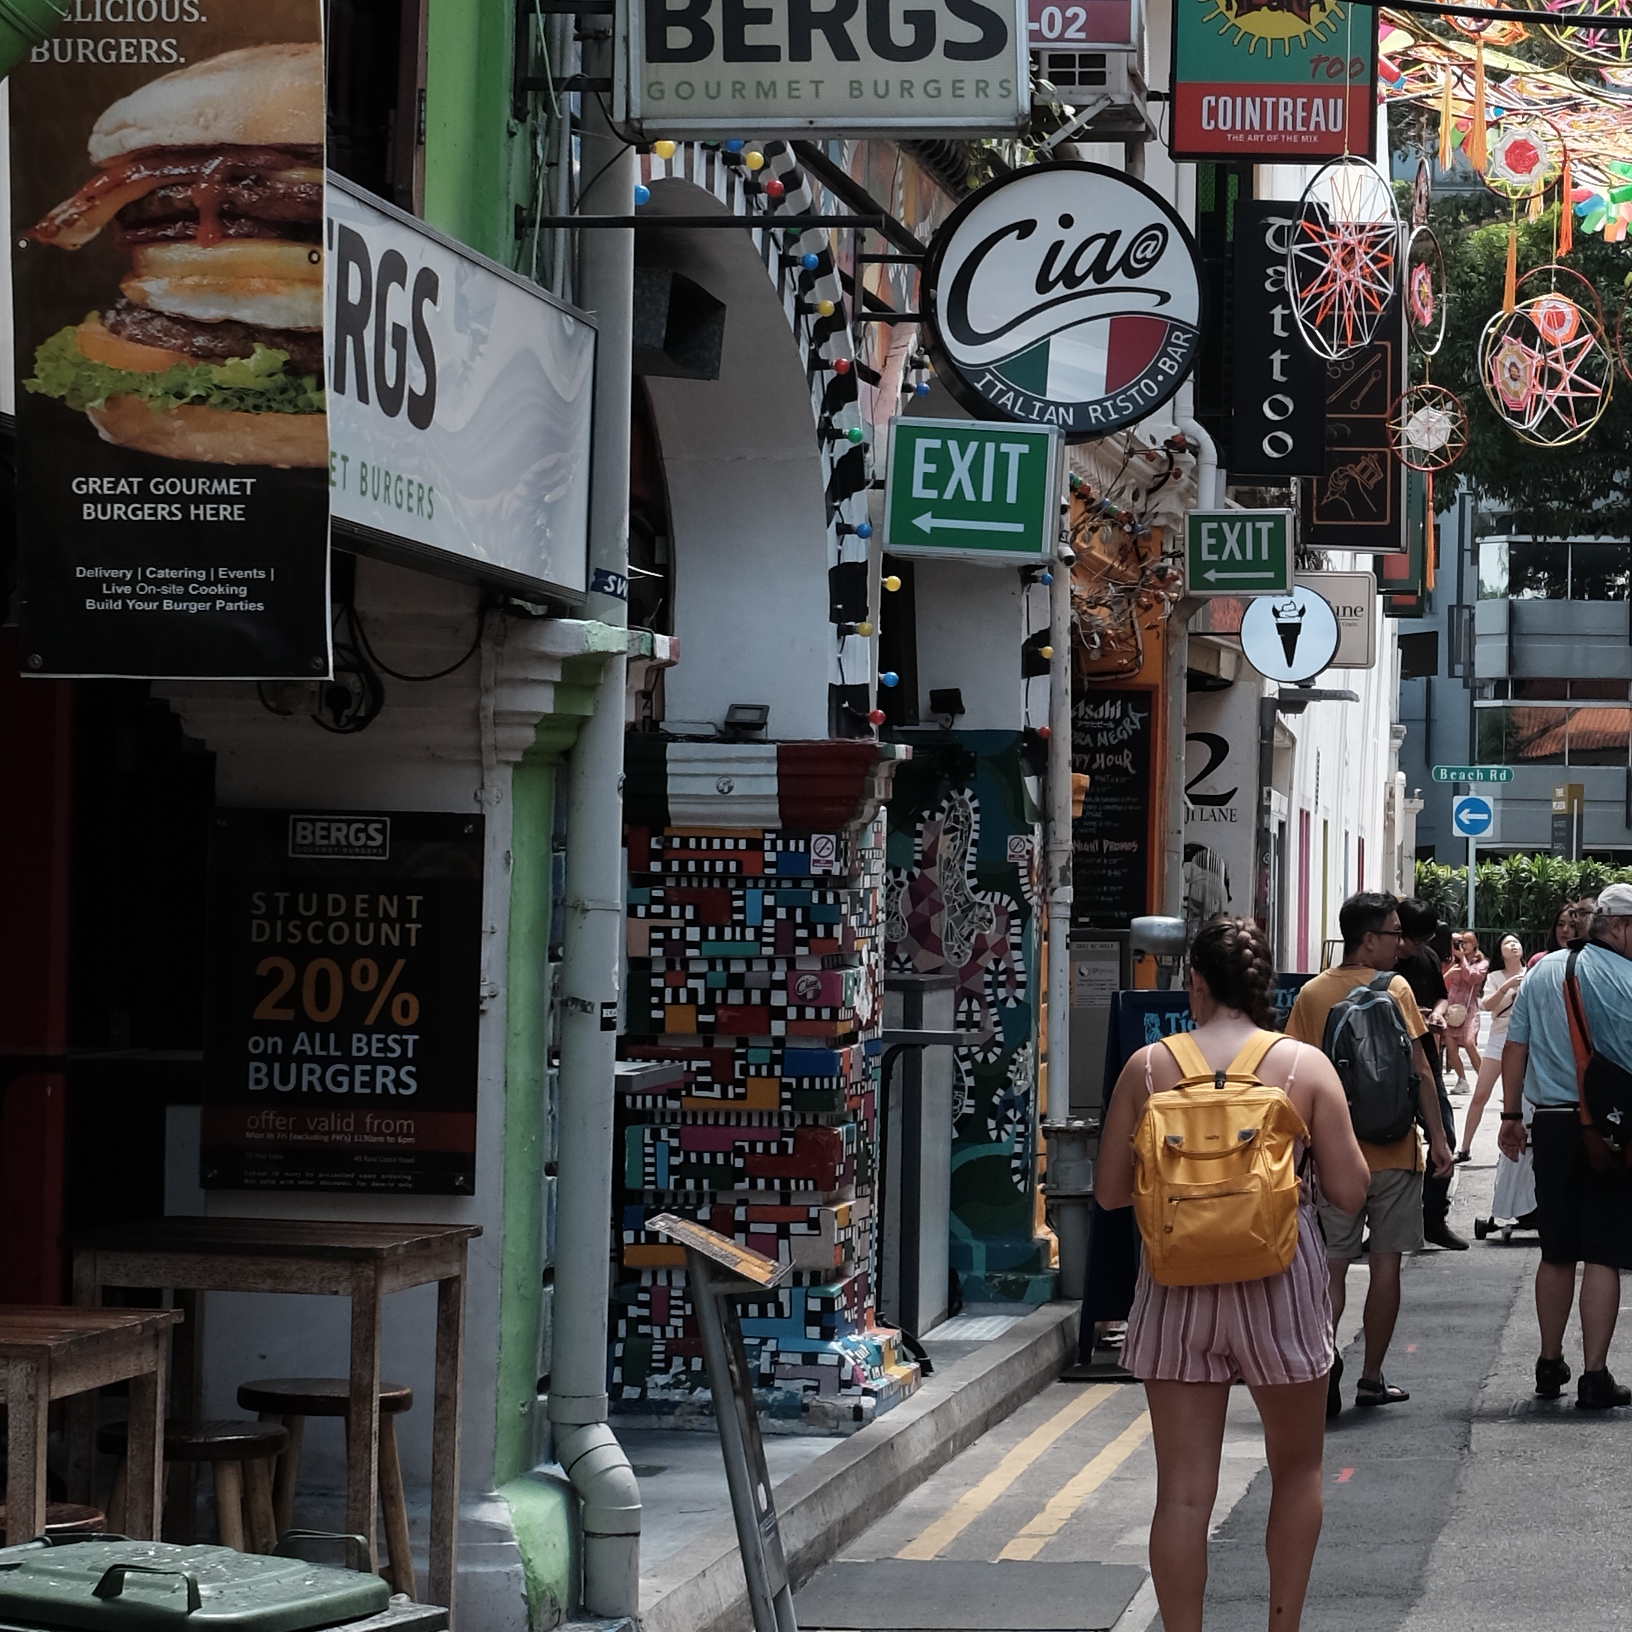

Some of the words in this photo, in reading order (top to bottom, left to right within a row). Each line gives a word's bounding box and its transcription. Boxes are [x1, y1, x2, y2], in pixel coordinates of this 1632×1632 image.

[646, 79, 825, 102] GOURMET
[849, 76, 1014, 100] BURGERS
[1201, 95, 1345, 133] COINTREAU
[1226, 134, 1246, 144] THE
[1247, 134, 1264, 144] ART
[1266, 134, 1279, 144] OF
[1281, 134, 1299, 144] THE
[327, 216, 440, 431] RGS
[973, 370, 1075, 427] ITALIAN
[912, 436, 1031, 504] EXIT
[71, 477, 144, 495] GREAT
[149, 477, 257, 495] GOURMET
[359, 460, 435, 521] BURGERS
[82, 503, 183, 521] BURGERS
[189, 504, 246, 521] HERE
[1200, 520, 1276, 562] EXIT
[75, 566, 133, 581] Delivery
[146, 567, 206, 581] Catering
[218, 568, 266, 579] Events
[102, 583, 132, 595] Live
[136, 583, 185, 595] On-site
[188, 583, 248, 597] Cooking
[85, 599, 122, 610] Build
[126, 599, 159, 610] Your
[162, 599, 212, 613] Burger
[215, 600, 265, 611] Parties
[1071, 699, 1122, 720] Asahi
[1096, 703, 1149, 748] NEGRA
[1440, 768, 1484, 782] Beach
[1489, 769, 1507, 782] Rd
[1200, 807, 1238, 824] LANE
[295, 821, 385, 848] BERGS
[251, 891, 424, 920] STUDENT
[250, 919, 423, 947] DISCOUNT
[252, 955, 420, 1027] 20%
[247, 1035, 283, 1055] on
[292, 1032, 342, 1057] ALL
[351, 1033, 420, 1059] BEST
[247, 1061, 418, 1096] BURGERS
[246, 1110, 298, 1131] offer
[305, 1112, 356, 1133] valid
[364, 1112, 416, 1135] from
